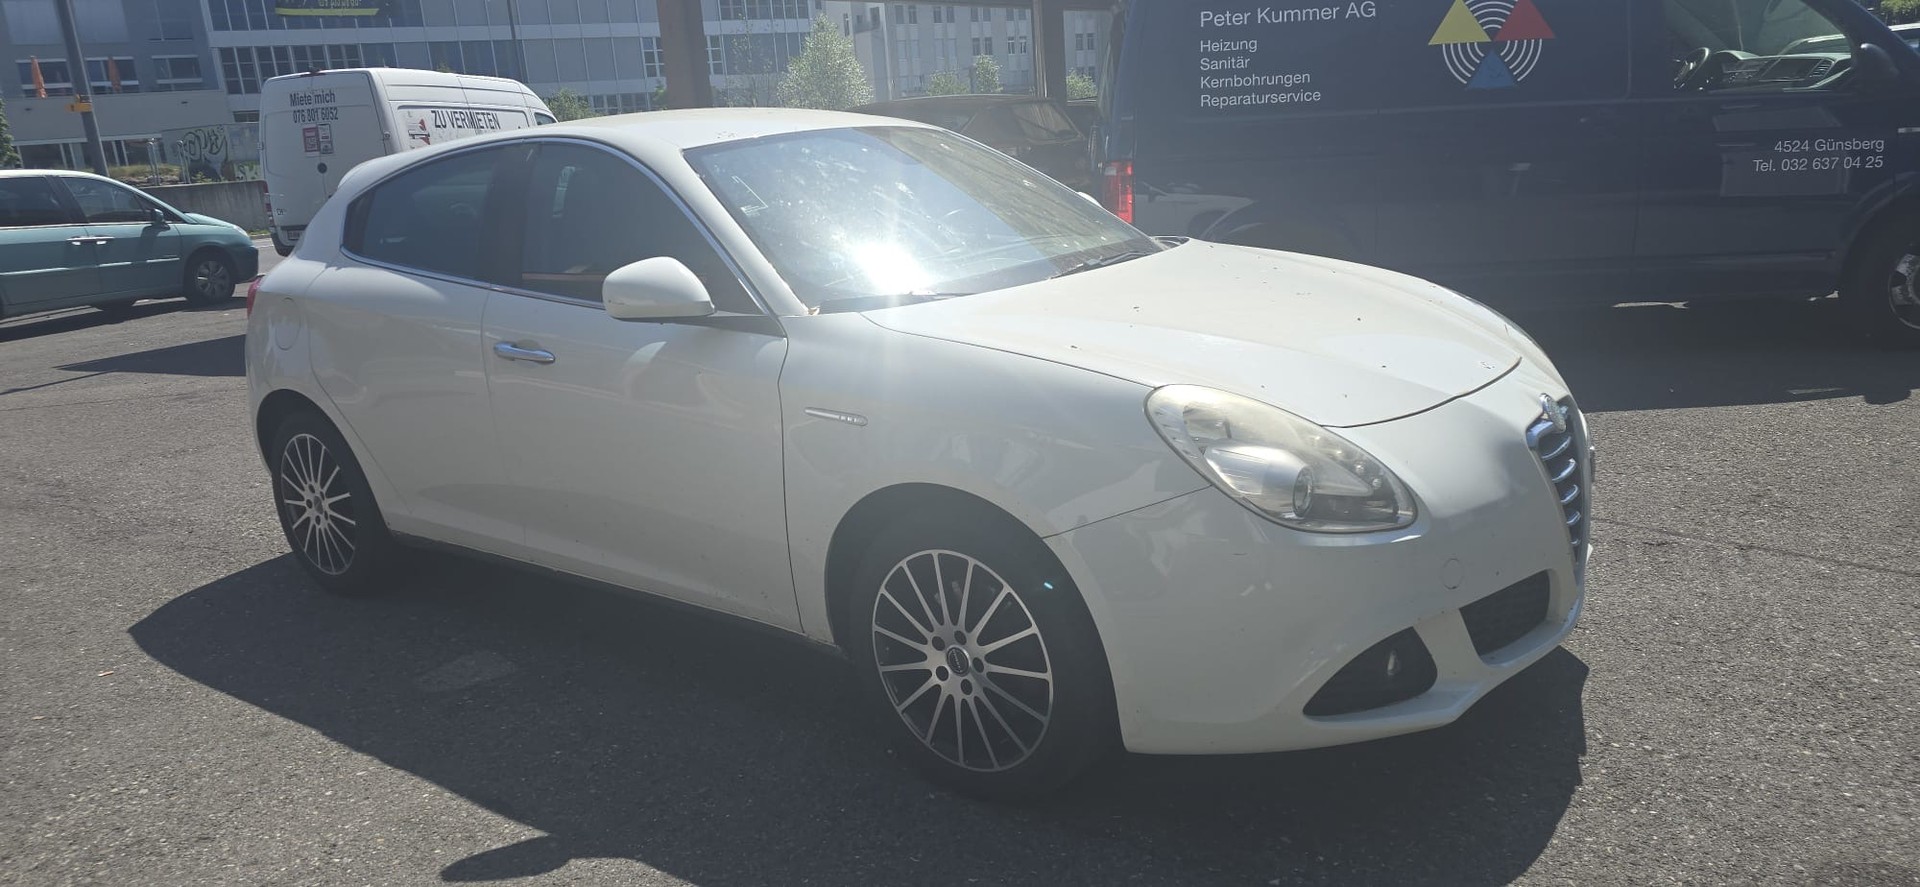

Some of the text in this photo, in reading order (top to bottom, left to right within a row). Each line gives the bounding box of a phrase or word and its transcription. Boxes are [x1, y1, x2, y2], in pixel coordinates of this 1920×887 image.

[1200, 1, 1376, 27] Peter Kummer AG
[1200, 39, 1258, 52] Heizung
[1200, 56, 1250, 70] Sanitär
[1200, 73, 1311, 89] Kernbohrungen
[289, 89, 336, 107] Miete mich
[1200, 89, 1321, 108] Reparaturservice
[431, 110, 501, 129] ZU VERMIETEN
[1774, 138, 1884, 153] 4524 Günsberg
[1753, 156, 1884, 172] Tel. 032 637 04 25
